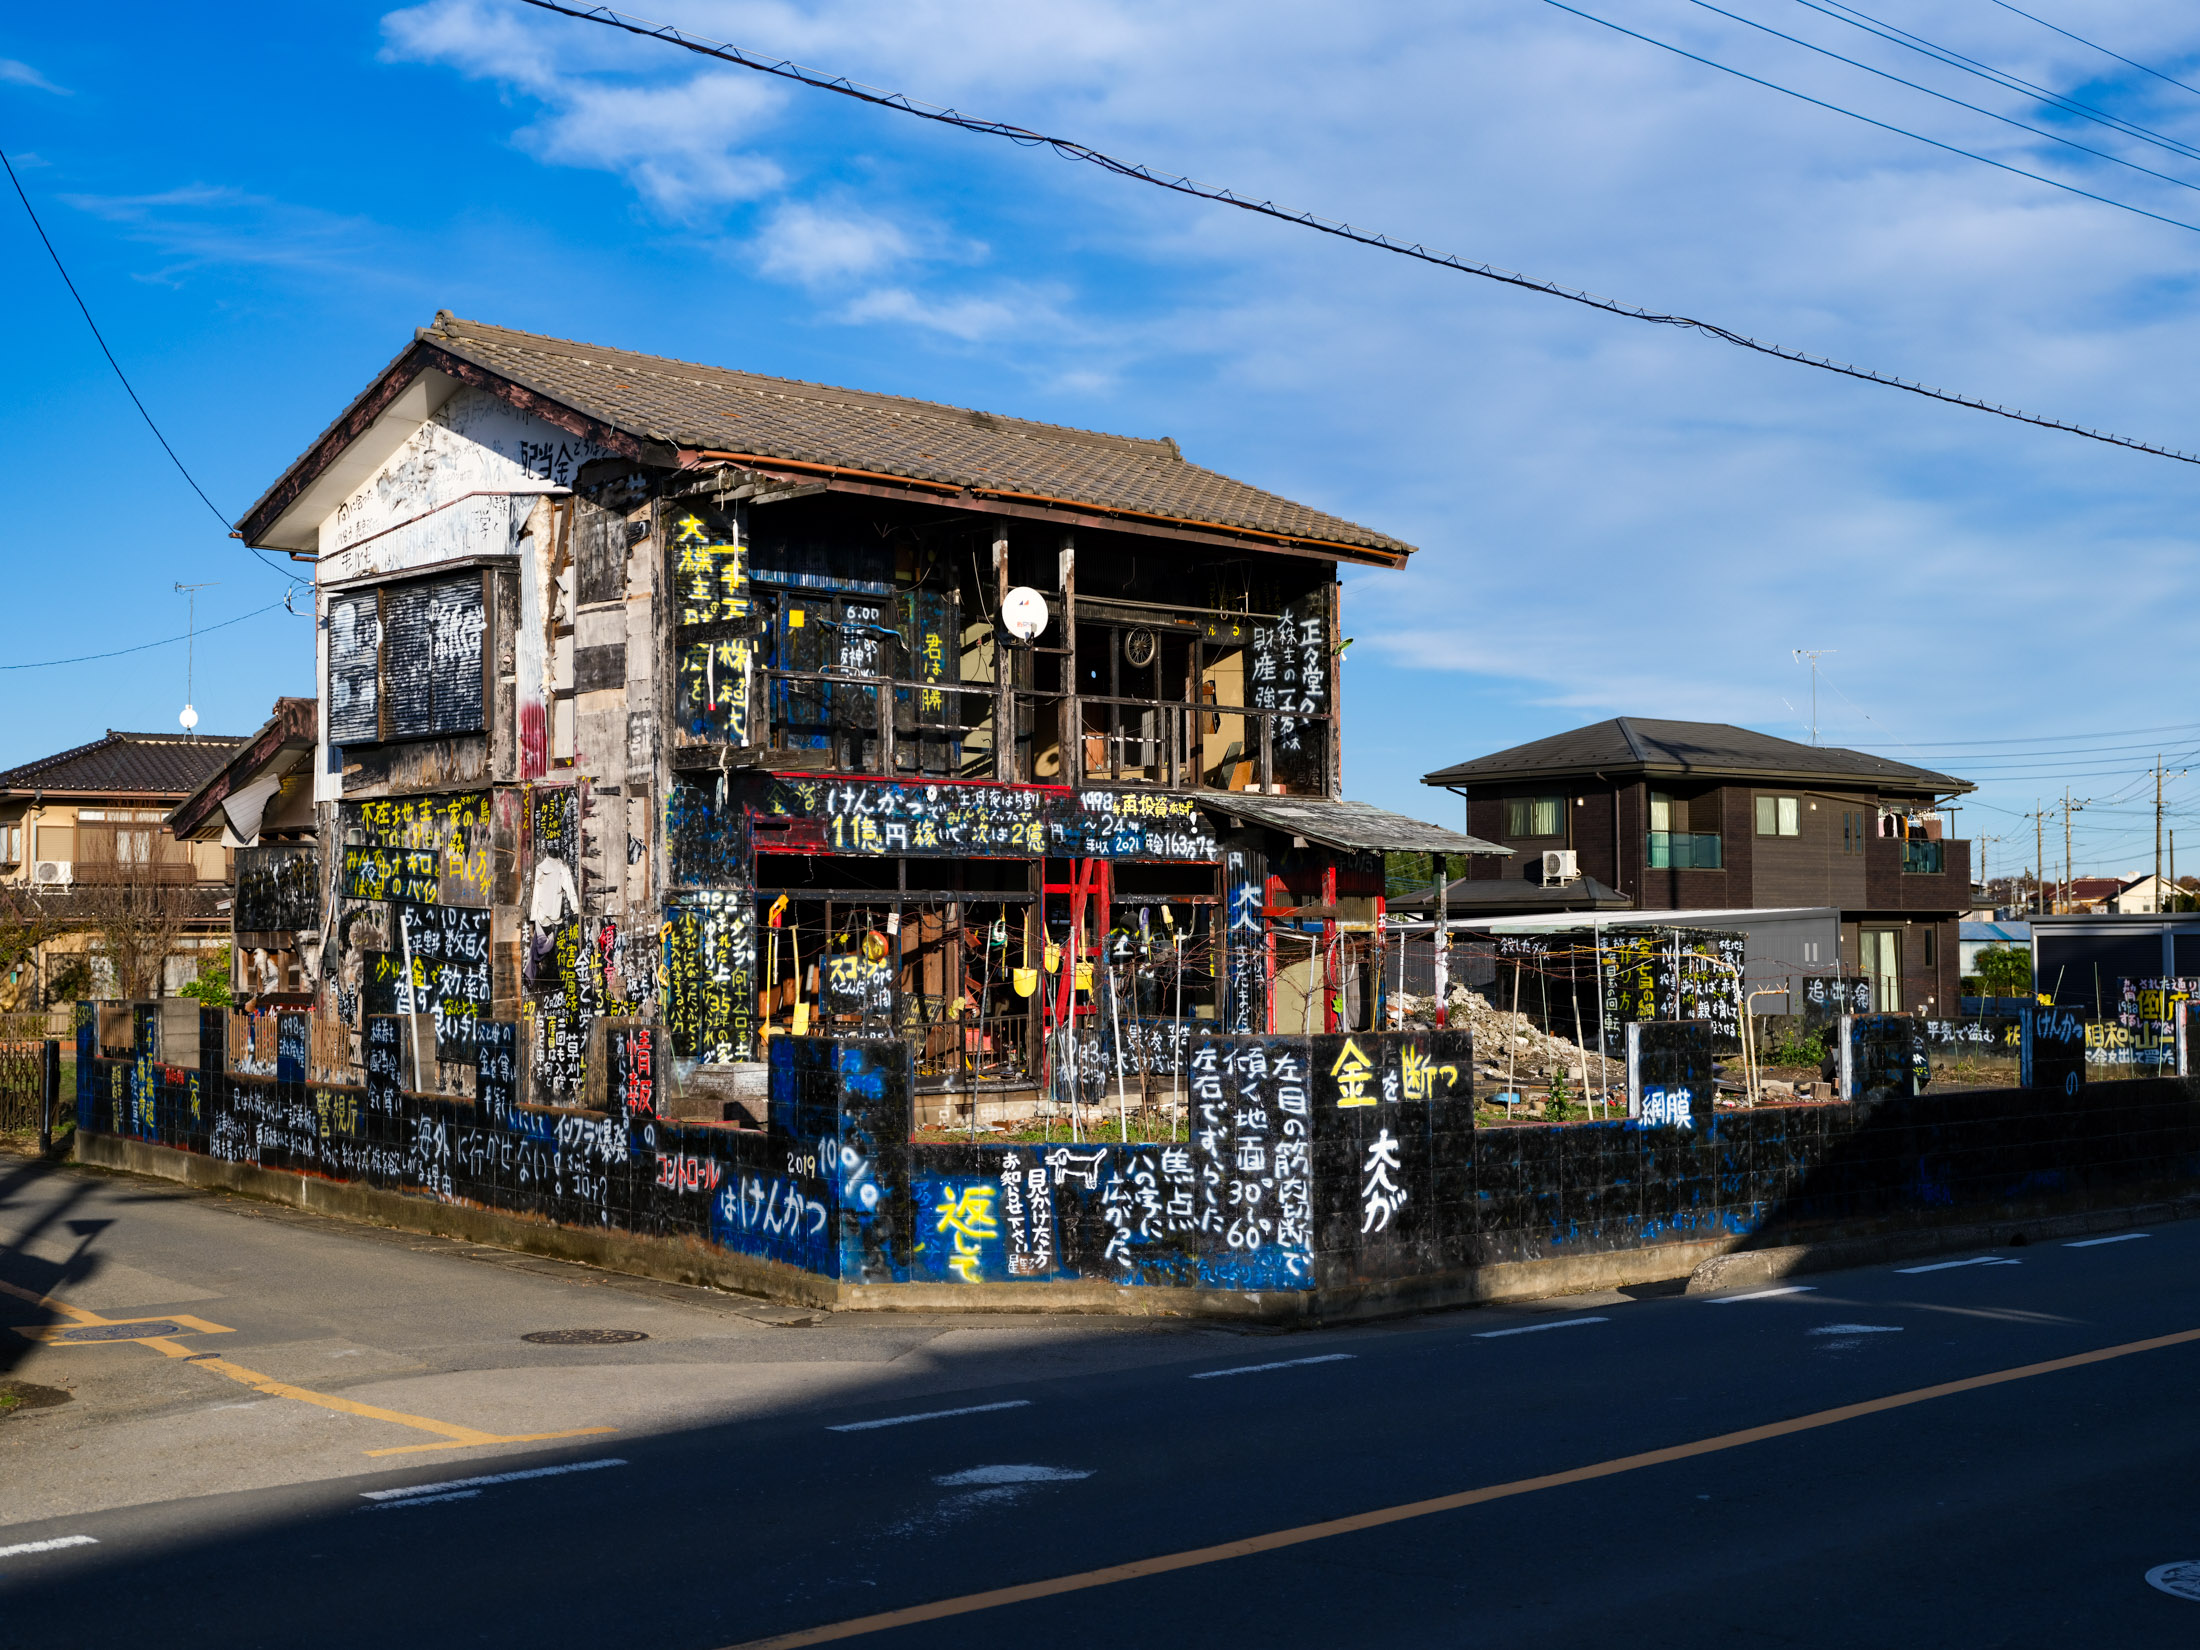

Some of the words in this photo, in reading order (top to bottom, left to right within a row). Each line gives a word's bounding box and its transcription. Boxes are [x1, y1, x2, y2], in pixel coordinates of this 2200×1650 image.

[520, 440, 574, 487] 配当金
[1252, 627, 1277, 740] 財産強
[1231, 880, 1263, 933] 大人
[2036, 1008, 2083, 1045] けんかつ
[626, 1028, 654, 1116] 情報
[1330, 1037, 1458, 1108] 金を断つ
[2064, 1070, 2080, 1097] の
[315, 1088, 359, 1139] 警視庁
[643, 1123, 656, 1147] の
[1192, 1047, 1228, 1232] 左右でずらした
[787, 1151, 816, 1179] 2019
[818, 1135, 879, 1209] 10%
[1273, 1052, 1314, 1277] 左目の筋肉切断で
[1360, 1128, 1408, 1234] 大人が
[720, 1175, 827, 1237] はけんかつ
[936, 1184, 998, 1284] 返して
[1000, 1151, 1029, 1254] お知らせ下さい
[1026, 1168, 1052, 1270] 見かけた方
[1101, 1170, 1133, 1267] 広がった
